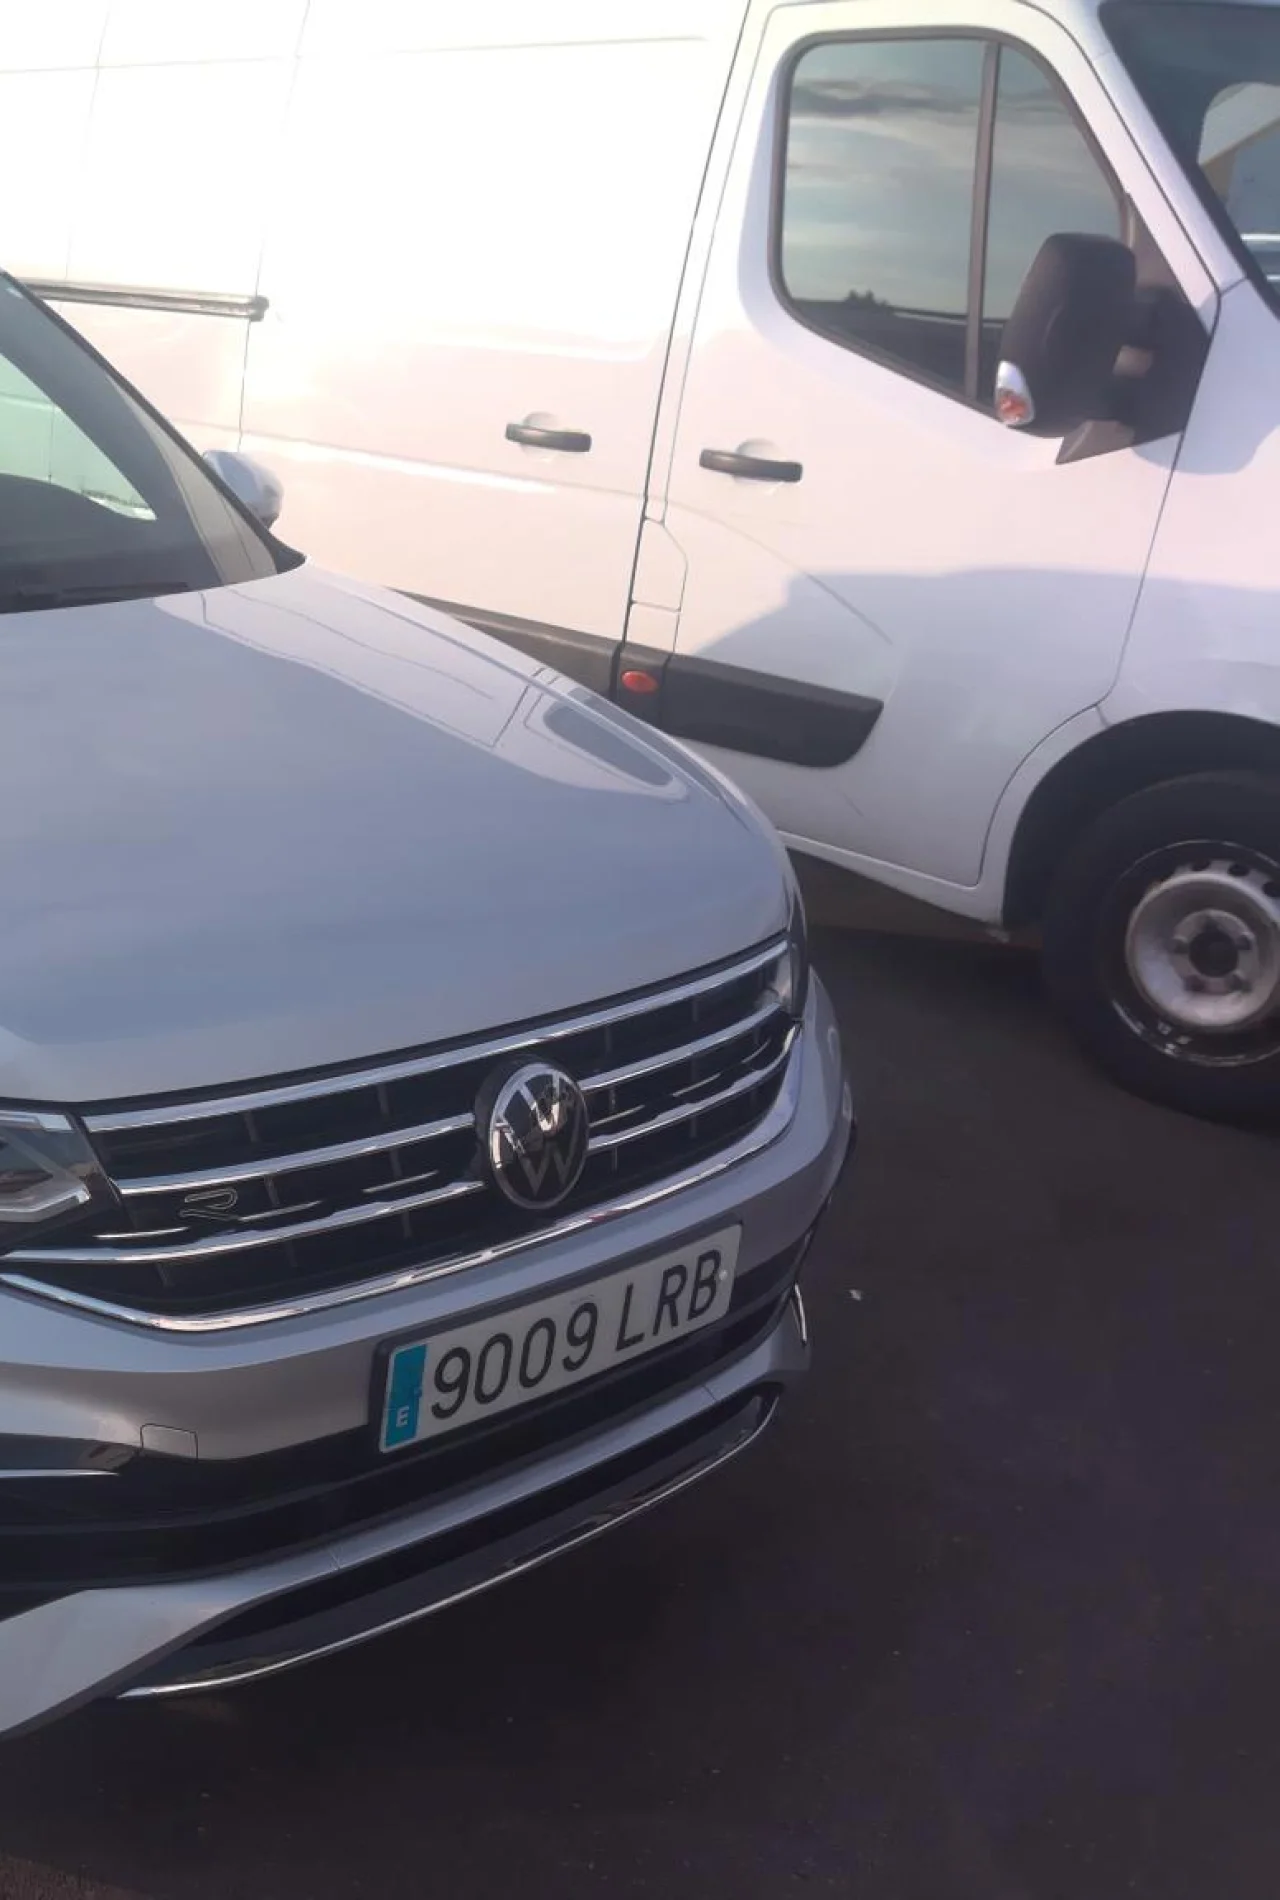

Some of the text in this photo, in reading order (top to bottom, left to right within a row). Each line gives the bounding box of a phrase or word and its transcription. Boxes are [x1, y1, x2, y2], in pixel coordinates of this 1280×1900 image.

[178, 1187, 239, 1221] R
[431, 1249, 721, 1419] 9009 LRB
[395, 1406, 410, 1428] E
